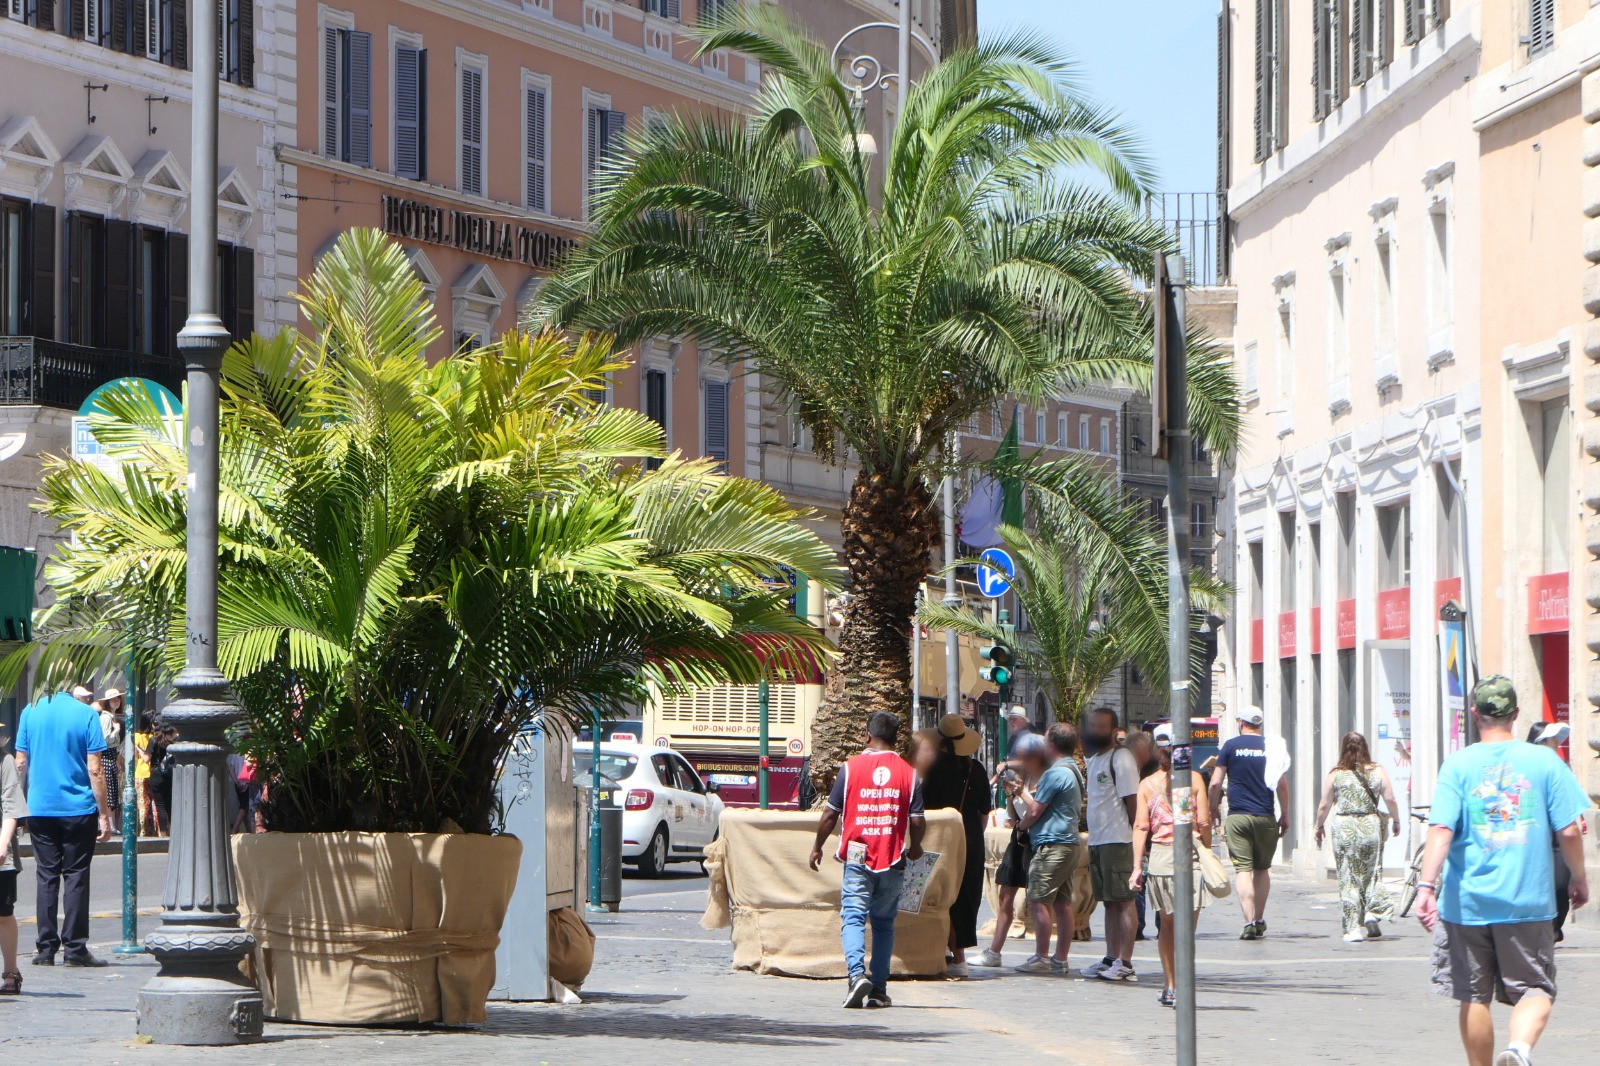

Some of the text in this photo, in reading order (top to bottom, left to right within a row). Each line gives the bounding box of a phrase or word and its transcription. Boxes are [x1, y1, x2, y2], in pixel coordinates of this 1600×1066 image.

[382, 194, 450, 246] HOTEL
[450, 209, 515, 260] DELLA
[692, 724, 760, 733] HOP-ON HOP-OFF
[791, 742, 801, 750] 100
[696, 763, 759, 772] BIGBUSTOURS.COM
[860, 788, 900, 798] OPEN BUS
[857, 803, 900, 812] HOP-ON HOP-OFF
[855, 815, 898, 825] SIGHTSEEING
[861, 826, 893, 836] ASK ME
